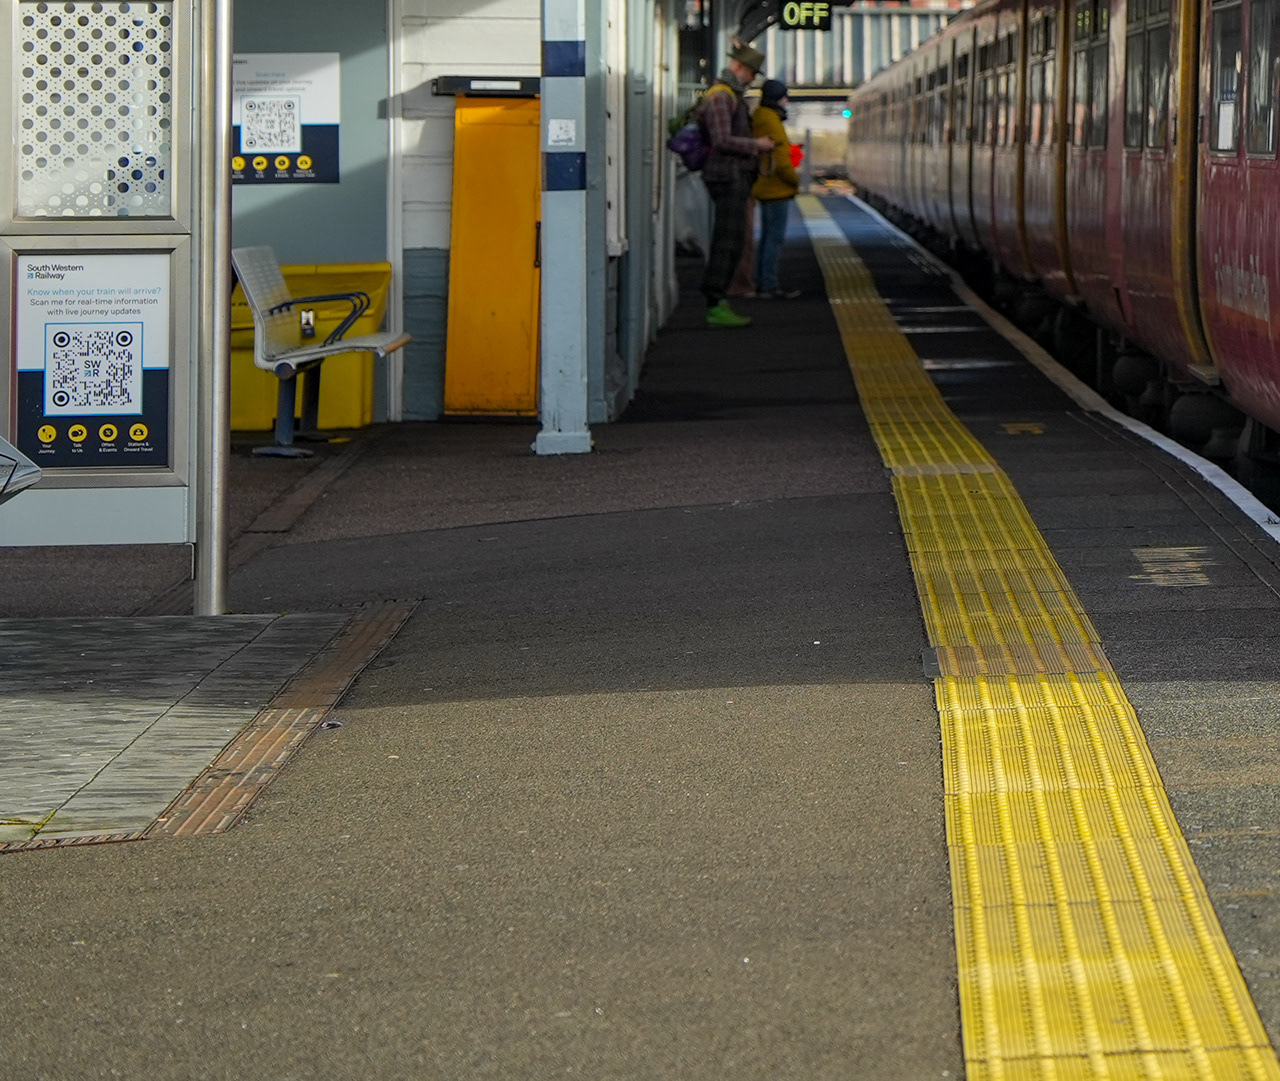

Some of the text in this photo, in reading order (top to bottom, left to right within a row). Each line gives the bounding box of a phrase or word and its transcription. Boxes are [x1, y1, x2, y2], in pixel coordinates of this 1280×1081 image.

[783, 1, 829, 25] OFF
[27, 264, 50, 272] South
[35, 272, 65, 280] Railway
[27, 288, 50, 296] Know
[77, 289, 95, 297] your
[118, 287, 132, 295] will
[133, 287, 162, 295] arrive?
[114, 297, 158, 305] information
[80, 308, 109, 317] journey
[110, 308, 141, 316] updates
[84, 360, 102, 369] SW
